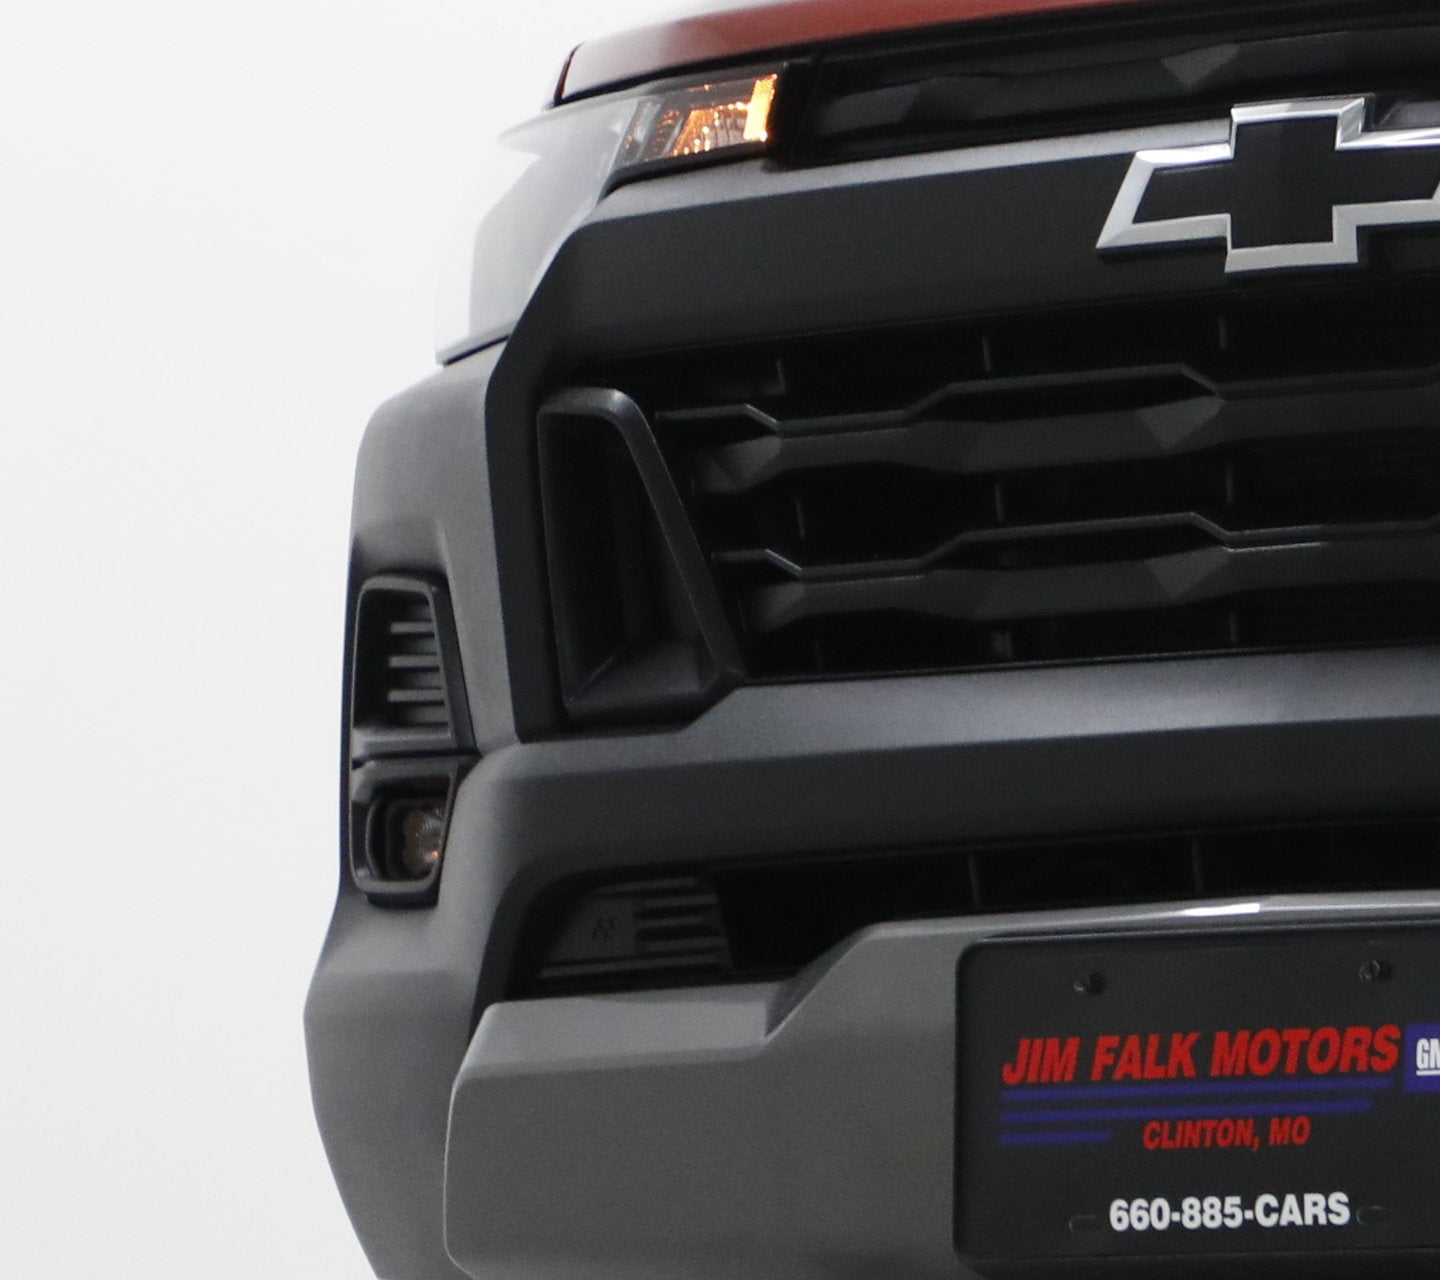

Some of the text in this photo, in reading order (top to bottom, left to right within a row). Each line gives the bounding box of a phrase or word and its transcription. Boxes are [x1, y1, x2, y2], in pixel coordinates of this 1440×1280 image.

[1003, 1025, 1400, 1084] JIM FALK MOTORS
[1142, 1116, 1311, 1151] CLINTON, MO
[1109, 1192, 1351, 1231] 660-885-CARS
